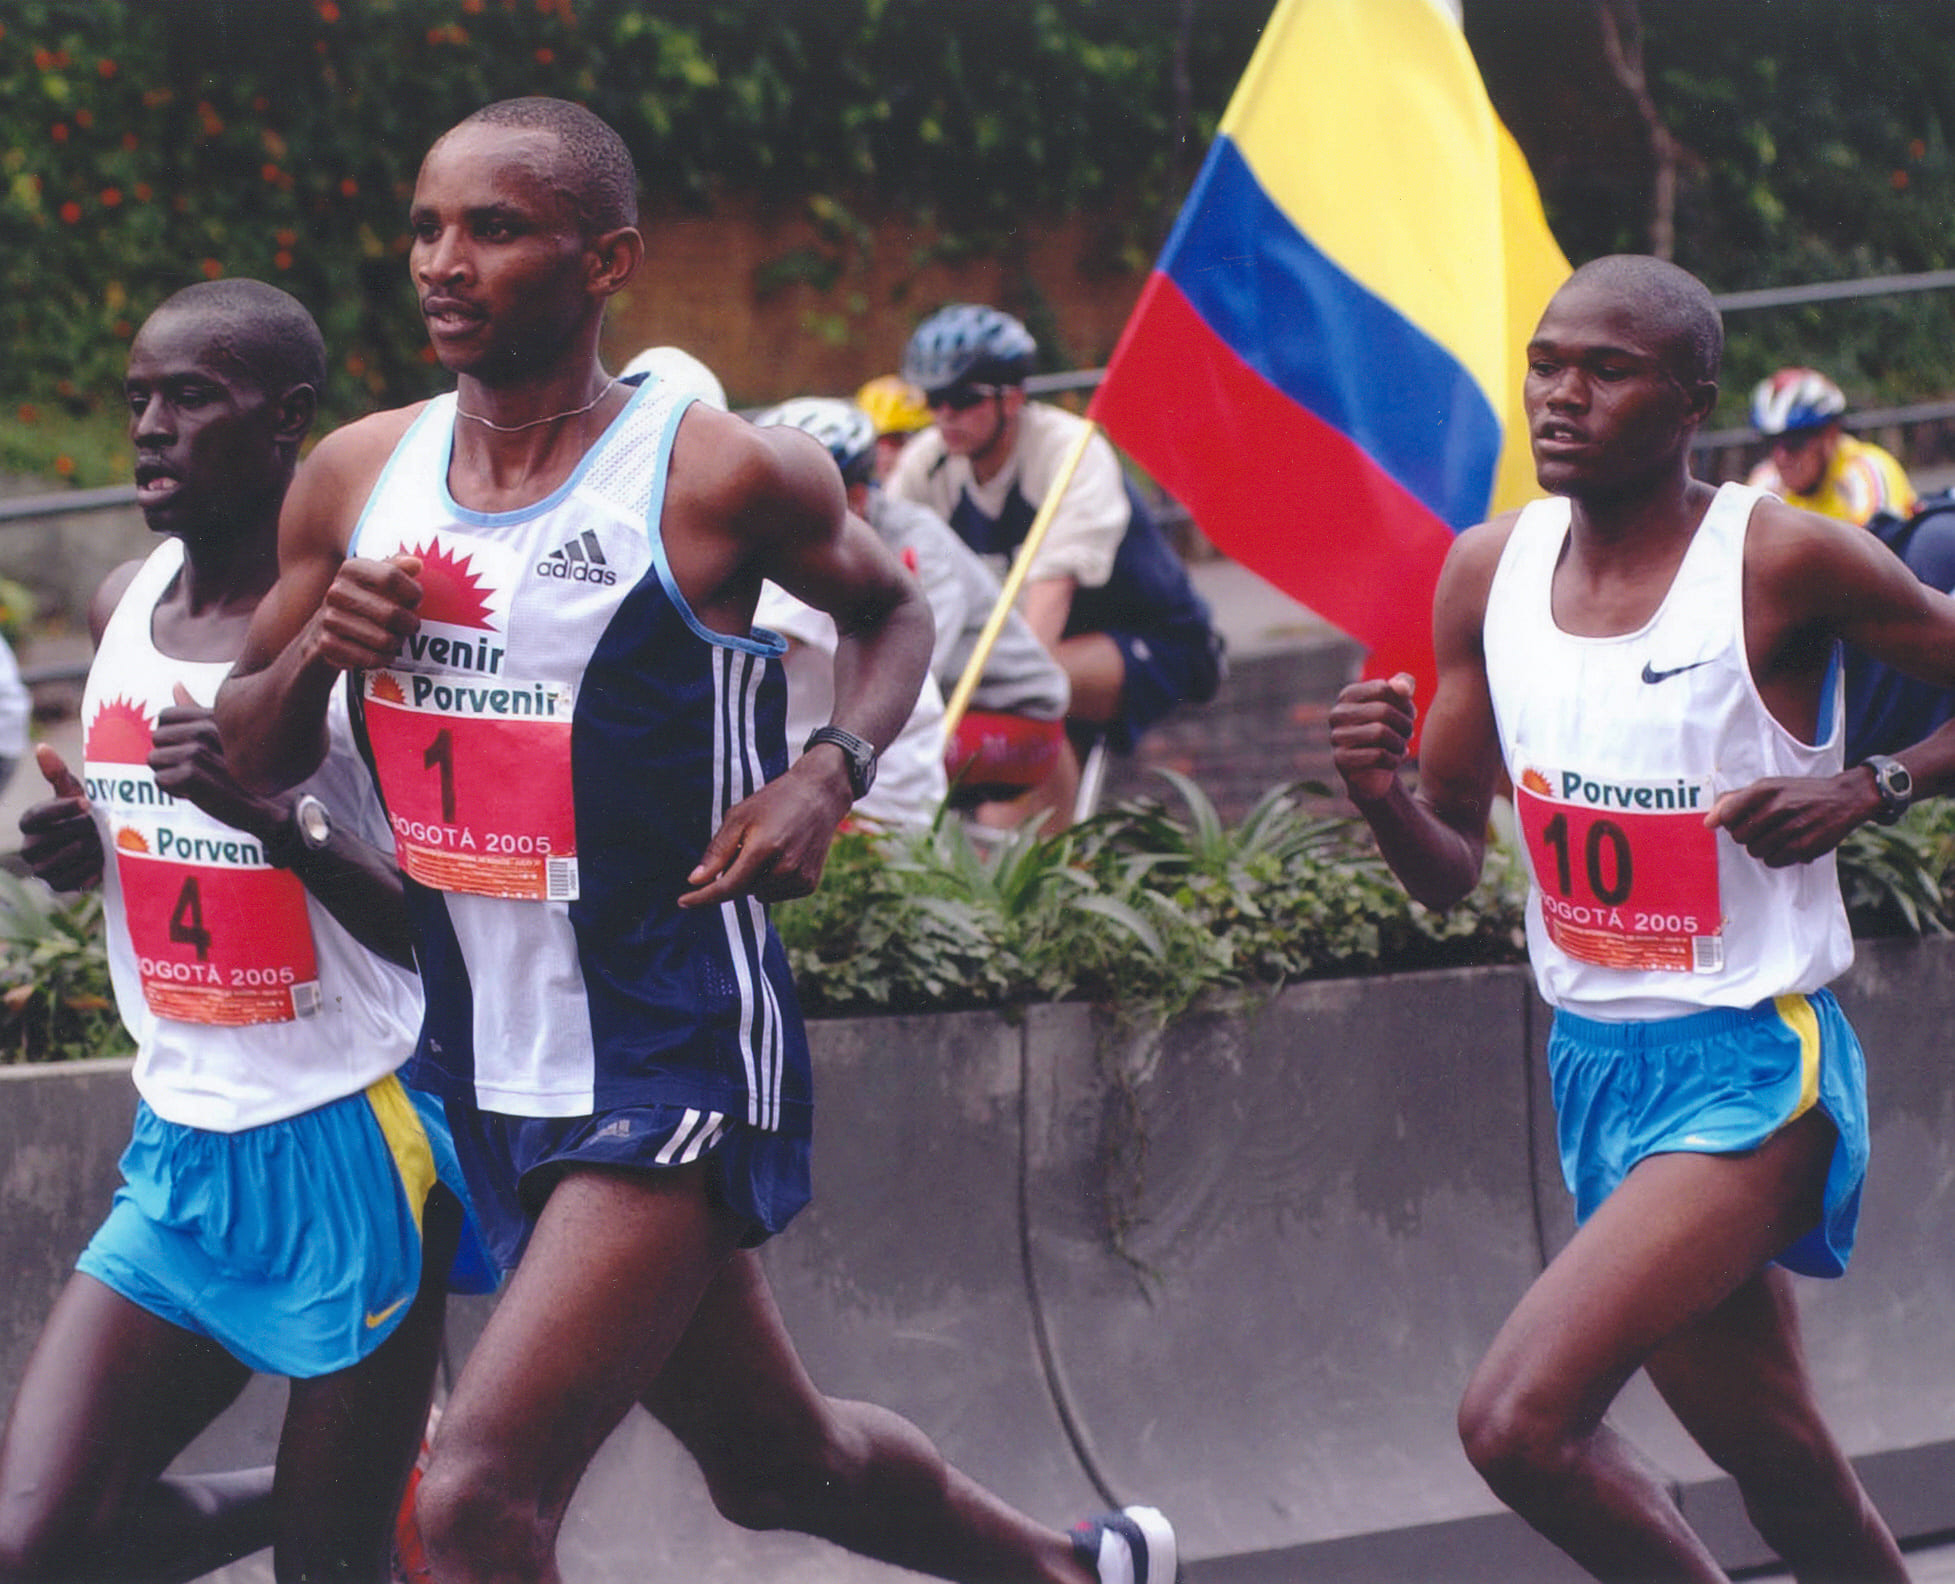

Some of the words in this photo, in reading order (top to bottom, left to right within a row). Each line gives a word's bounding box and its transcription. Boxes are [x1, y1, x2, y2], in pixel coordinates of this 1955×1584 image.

[537, 560, 617, 586] adidas
[396, 633, 505, 675] venir
[411, 675, 559, 716] Porvenir
[424, 728, 457, 824] 1
[1561, 770, 1701, 809] Porvenir
[485, 833, 552, 854] 2005
[1543, 812, 1634, 907] 10
[170, 876, 212, 962] 4
[1541, 895, 1625, 929] OGOTÁ
[1634, 913, 1699, 933] 2005
[137, 956, 223, 986] OGOTÁ
[230, 966, 295, 987] 2005
